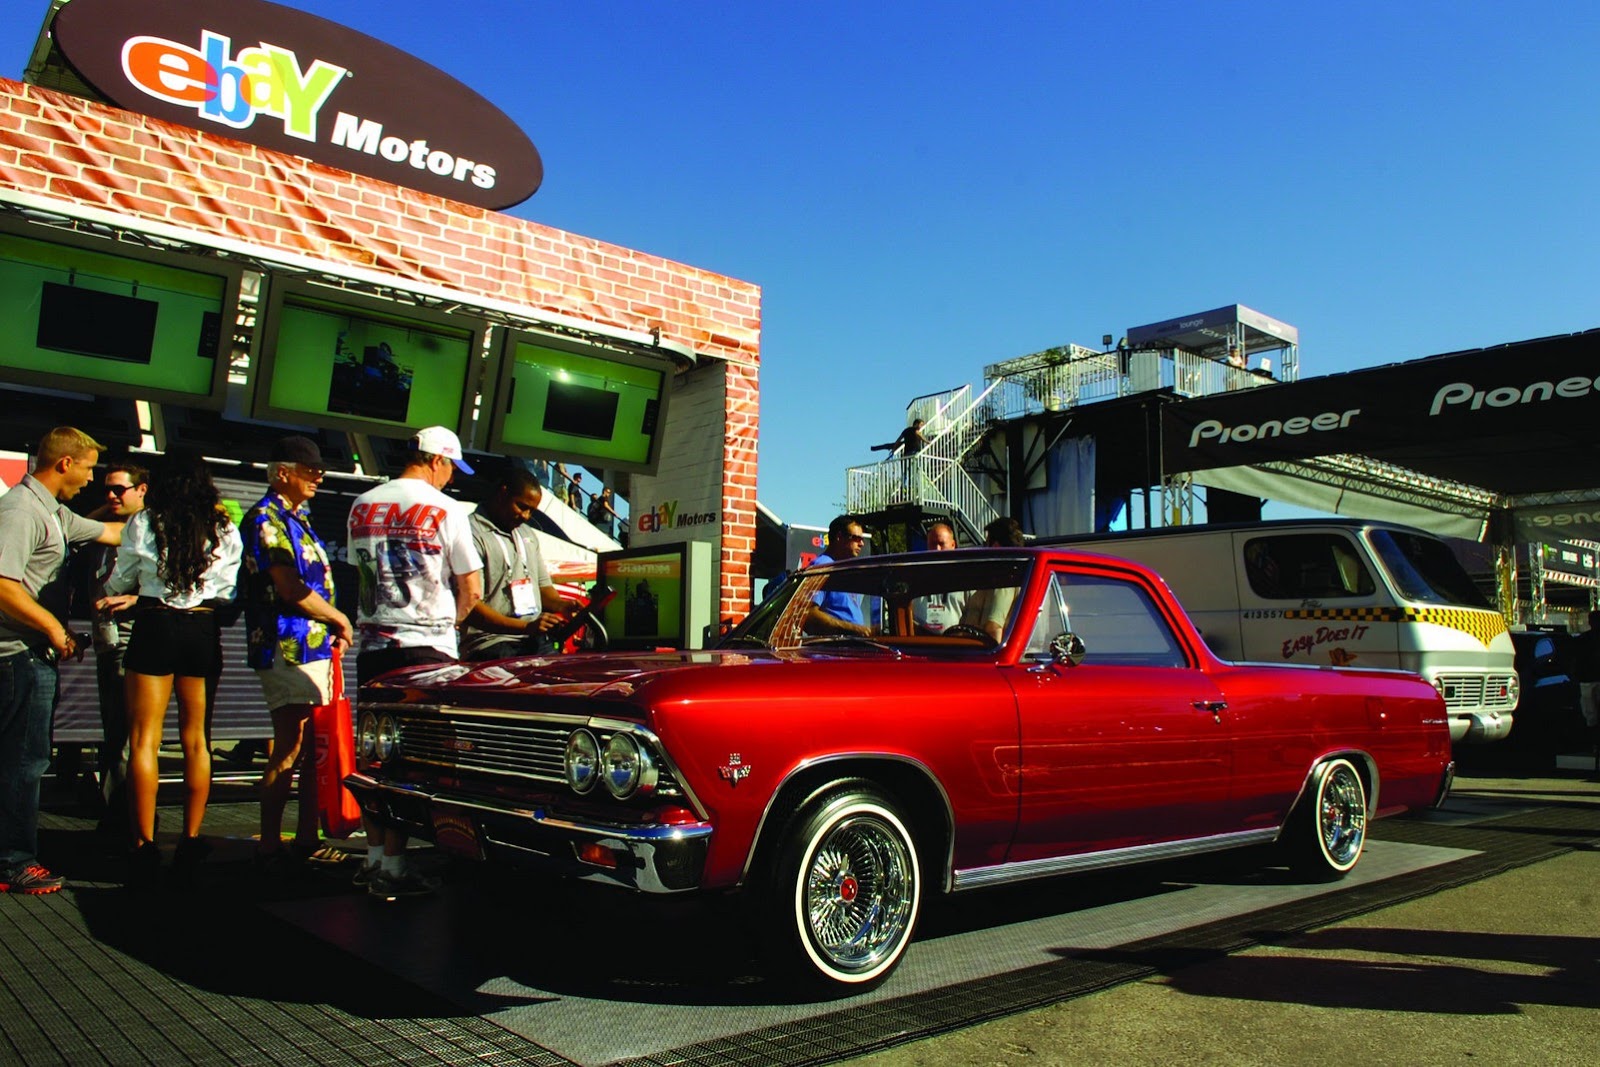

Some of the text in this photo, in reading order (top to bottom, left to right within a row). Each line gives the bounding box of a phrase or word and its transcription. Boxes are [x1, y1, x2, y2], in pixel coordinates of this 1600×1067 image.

[330, 111, 496, 189] Motors
[1429, 375, 1600, 416] Pione
[1188, 409, 1361, 448] Pioneer
[676, 512, 716, 527] Motors
[388, 528, 436, 537] SHOW
[812, 533, 830, 549] eba
[1243, 611, 1283, 619] 413557
